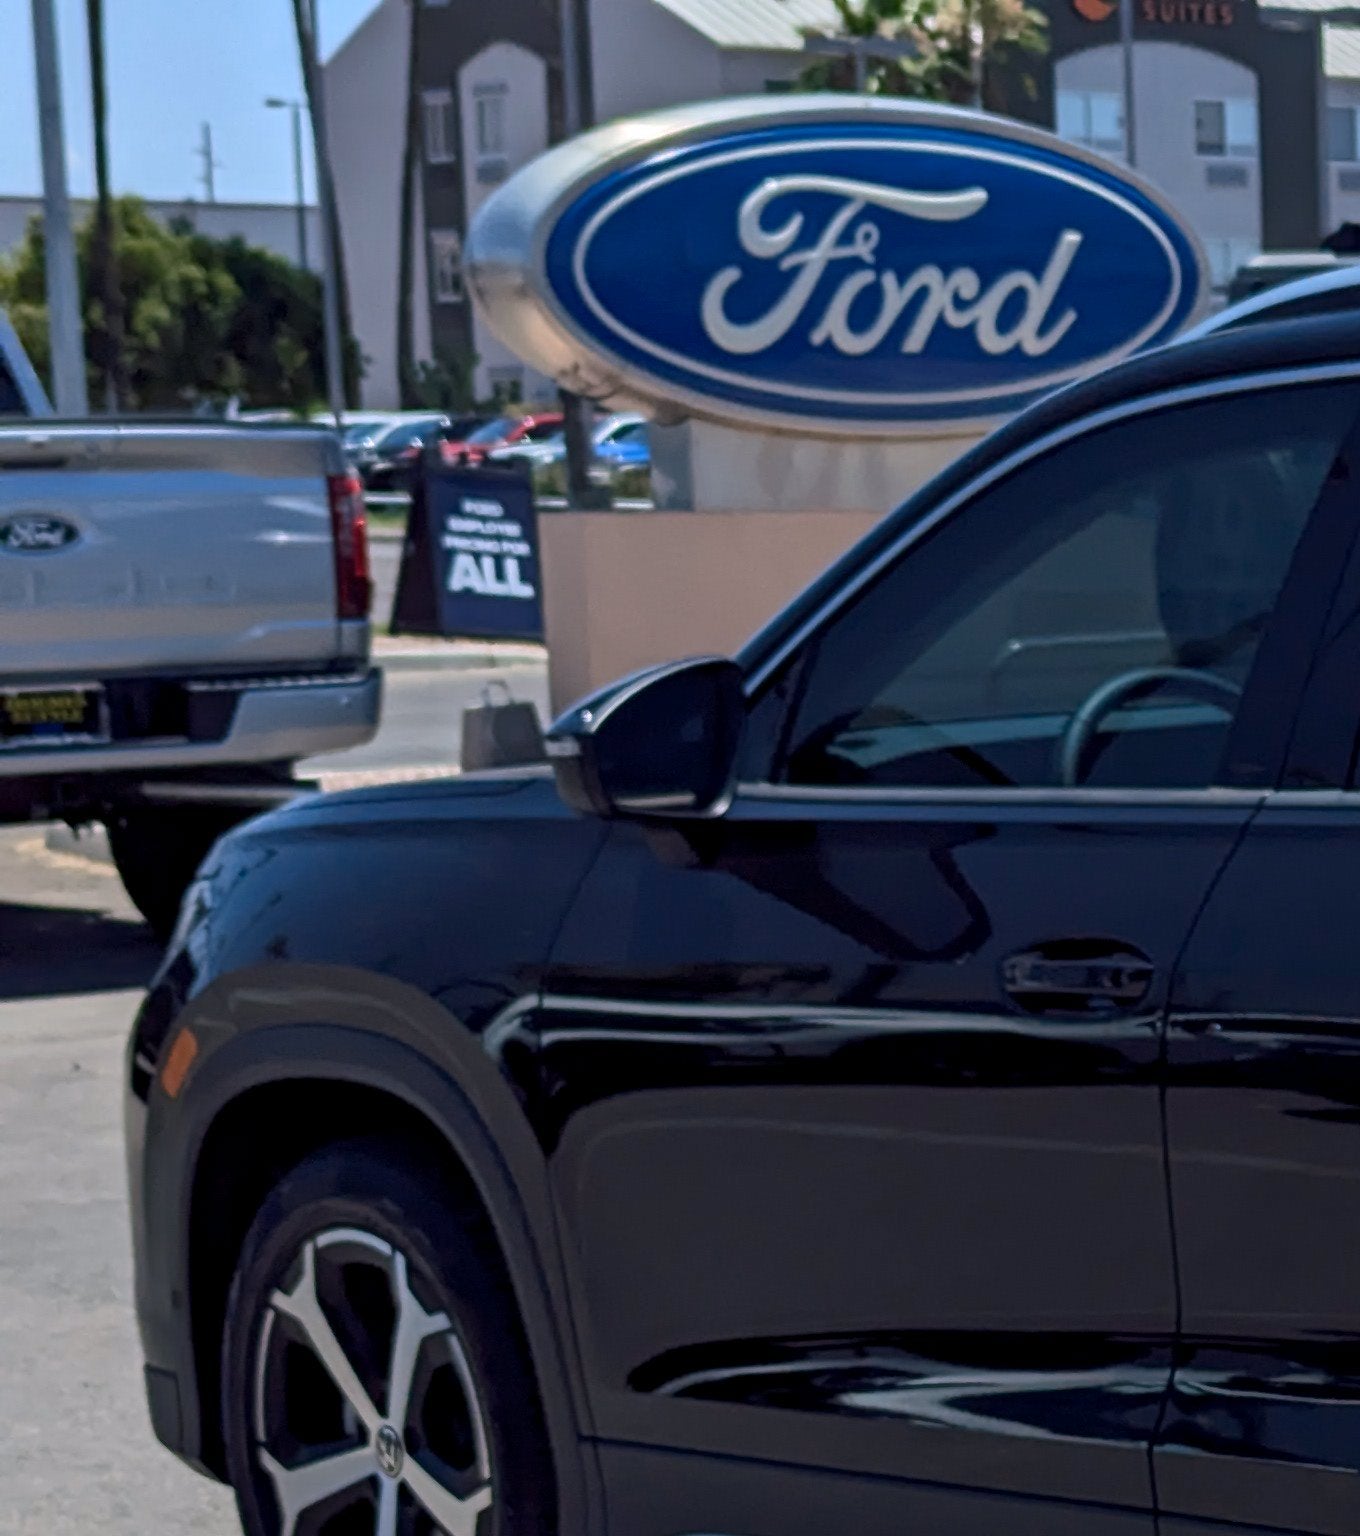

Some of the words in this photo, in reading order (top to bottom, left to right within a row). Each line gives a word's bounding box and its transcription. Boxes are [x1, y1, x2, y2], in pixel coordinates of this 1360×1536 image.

[1143, 0, 1233, 25] SUITES
[701, 174, 1083, 357] Ford
[447, 552, 535, 599] ALL
